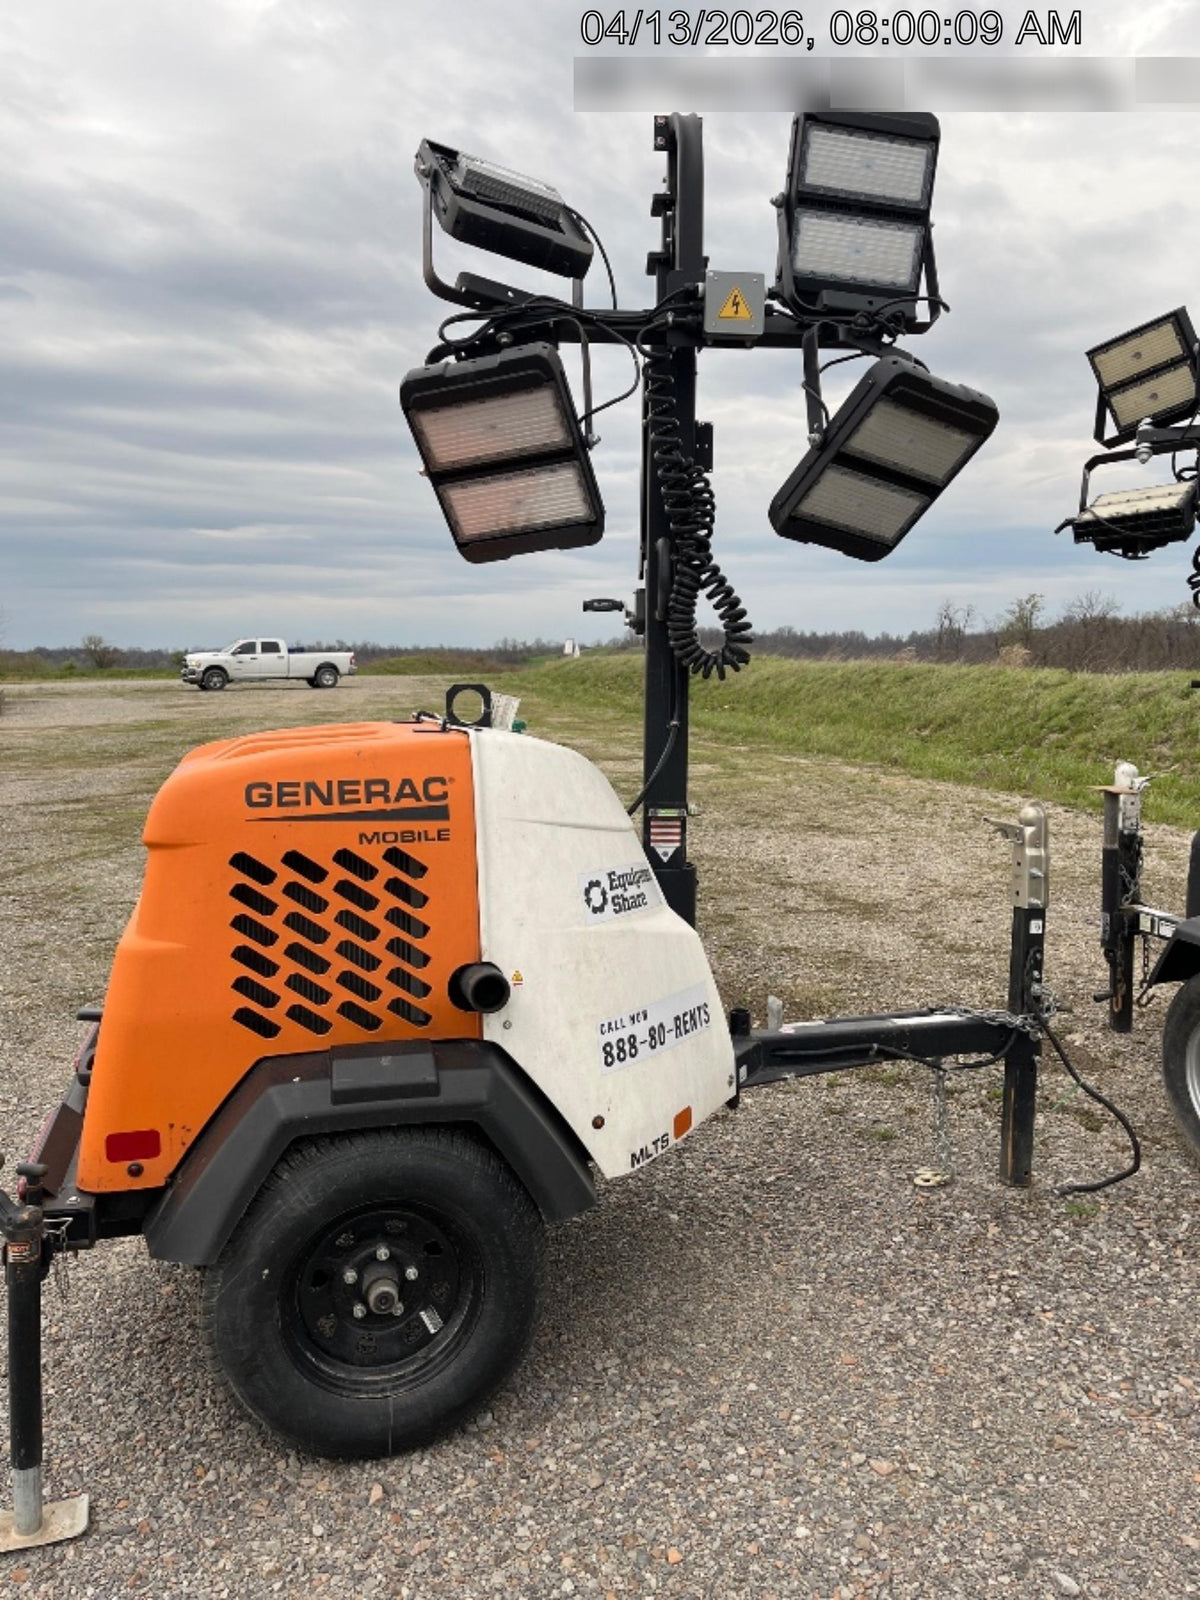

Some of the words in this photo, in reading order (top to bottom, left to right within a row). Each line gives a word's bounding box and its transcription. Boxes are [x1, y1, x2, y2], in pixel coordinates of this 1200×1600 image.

[245, 777, 449, 808] GENERAC
[358, 828, 450, 845] MOBILE
[611, 892, 648, 914] Share
[600, 1018, 626, 1035] CALL
[602, 1002, 710, 1067] 888-80-RENTS
